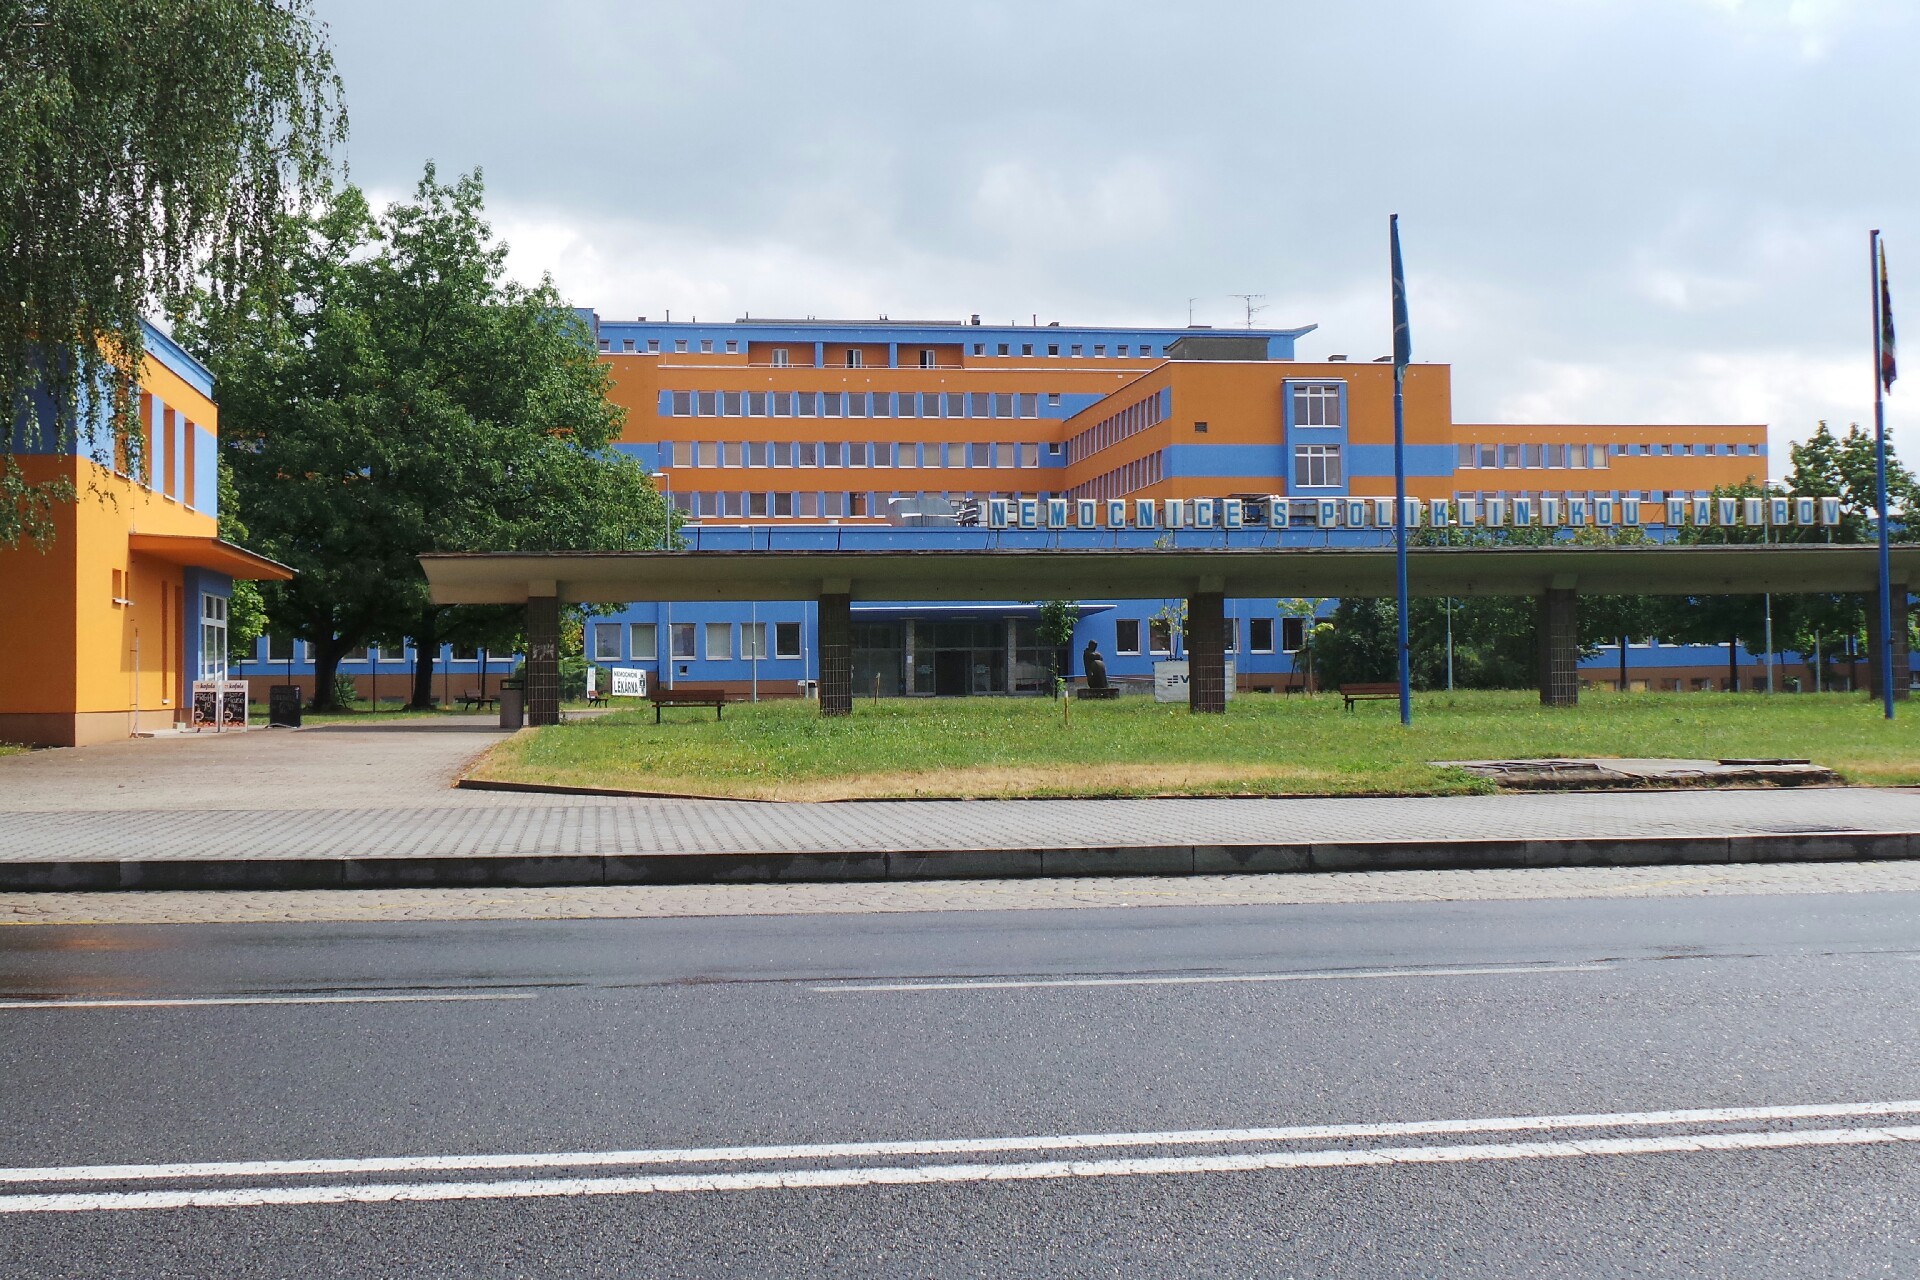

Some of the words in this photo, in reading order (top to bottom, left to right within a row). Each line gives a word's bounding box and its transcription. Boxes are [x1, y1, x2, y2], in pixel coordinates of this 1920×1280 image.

[991, 501, 1240, 527] NEMOCNICE
[1273, 501, 1287, 527] S
[1321, 501, 1638, 527] POLIKLINIKOU
